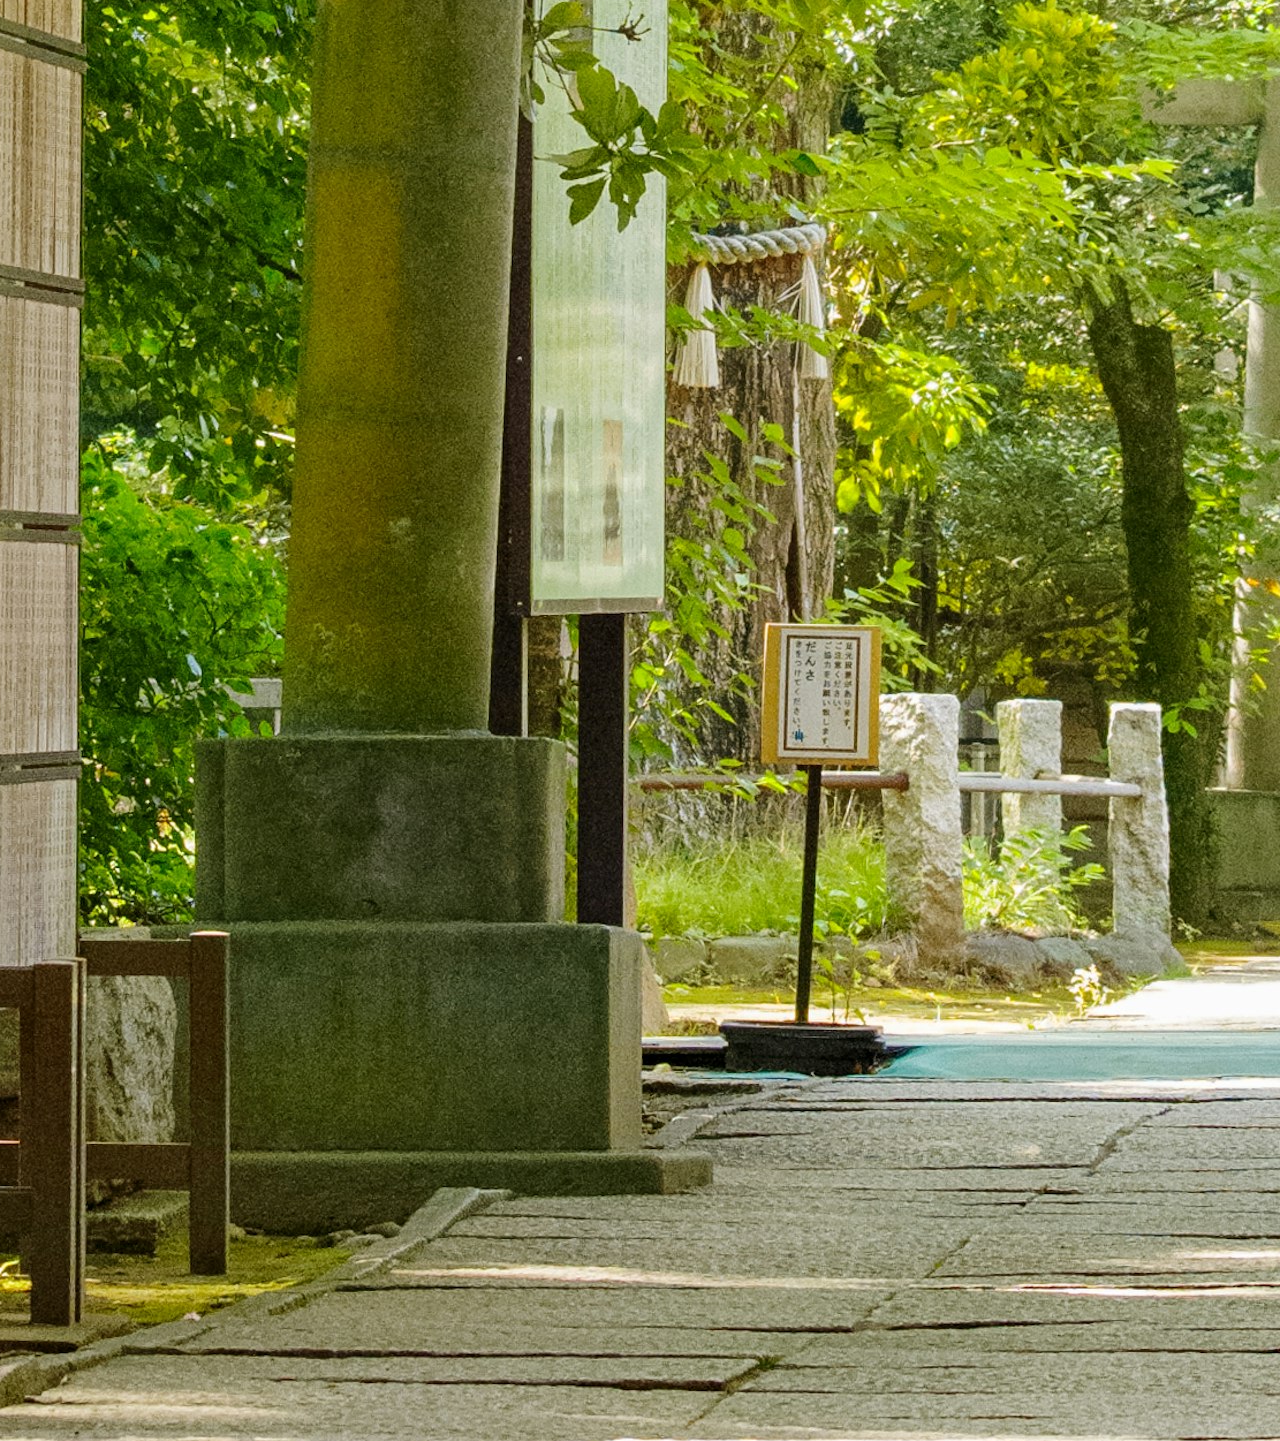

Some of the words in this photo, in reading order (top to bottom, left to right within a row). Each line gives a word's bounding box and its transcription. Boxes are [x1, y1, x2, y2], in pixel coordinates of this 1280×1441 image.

[804, 641, 817, 681] だんさ
[832, 641, 843, 711] ご注意ください。
